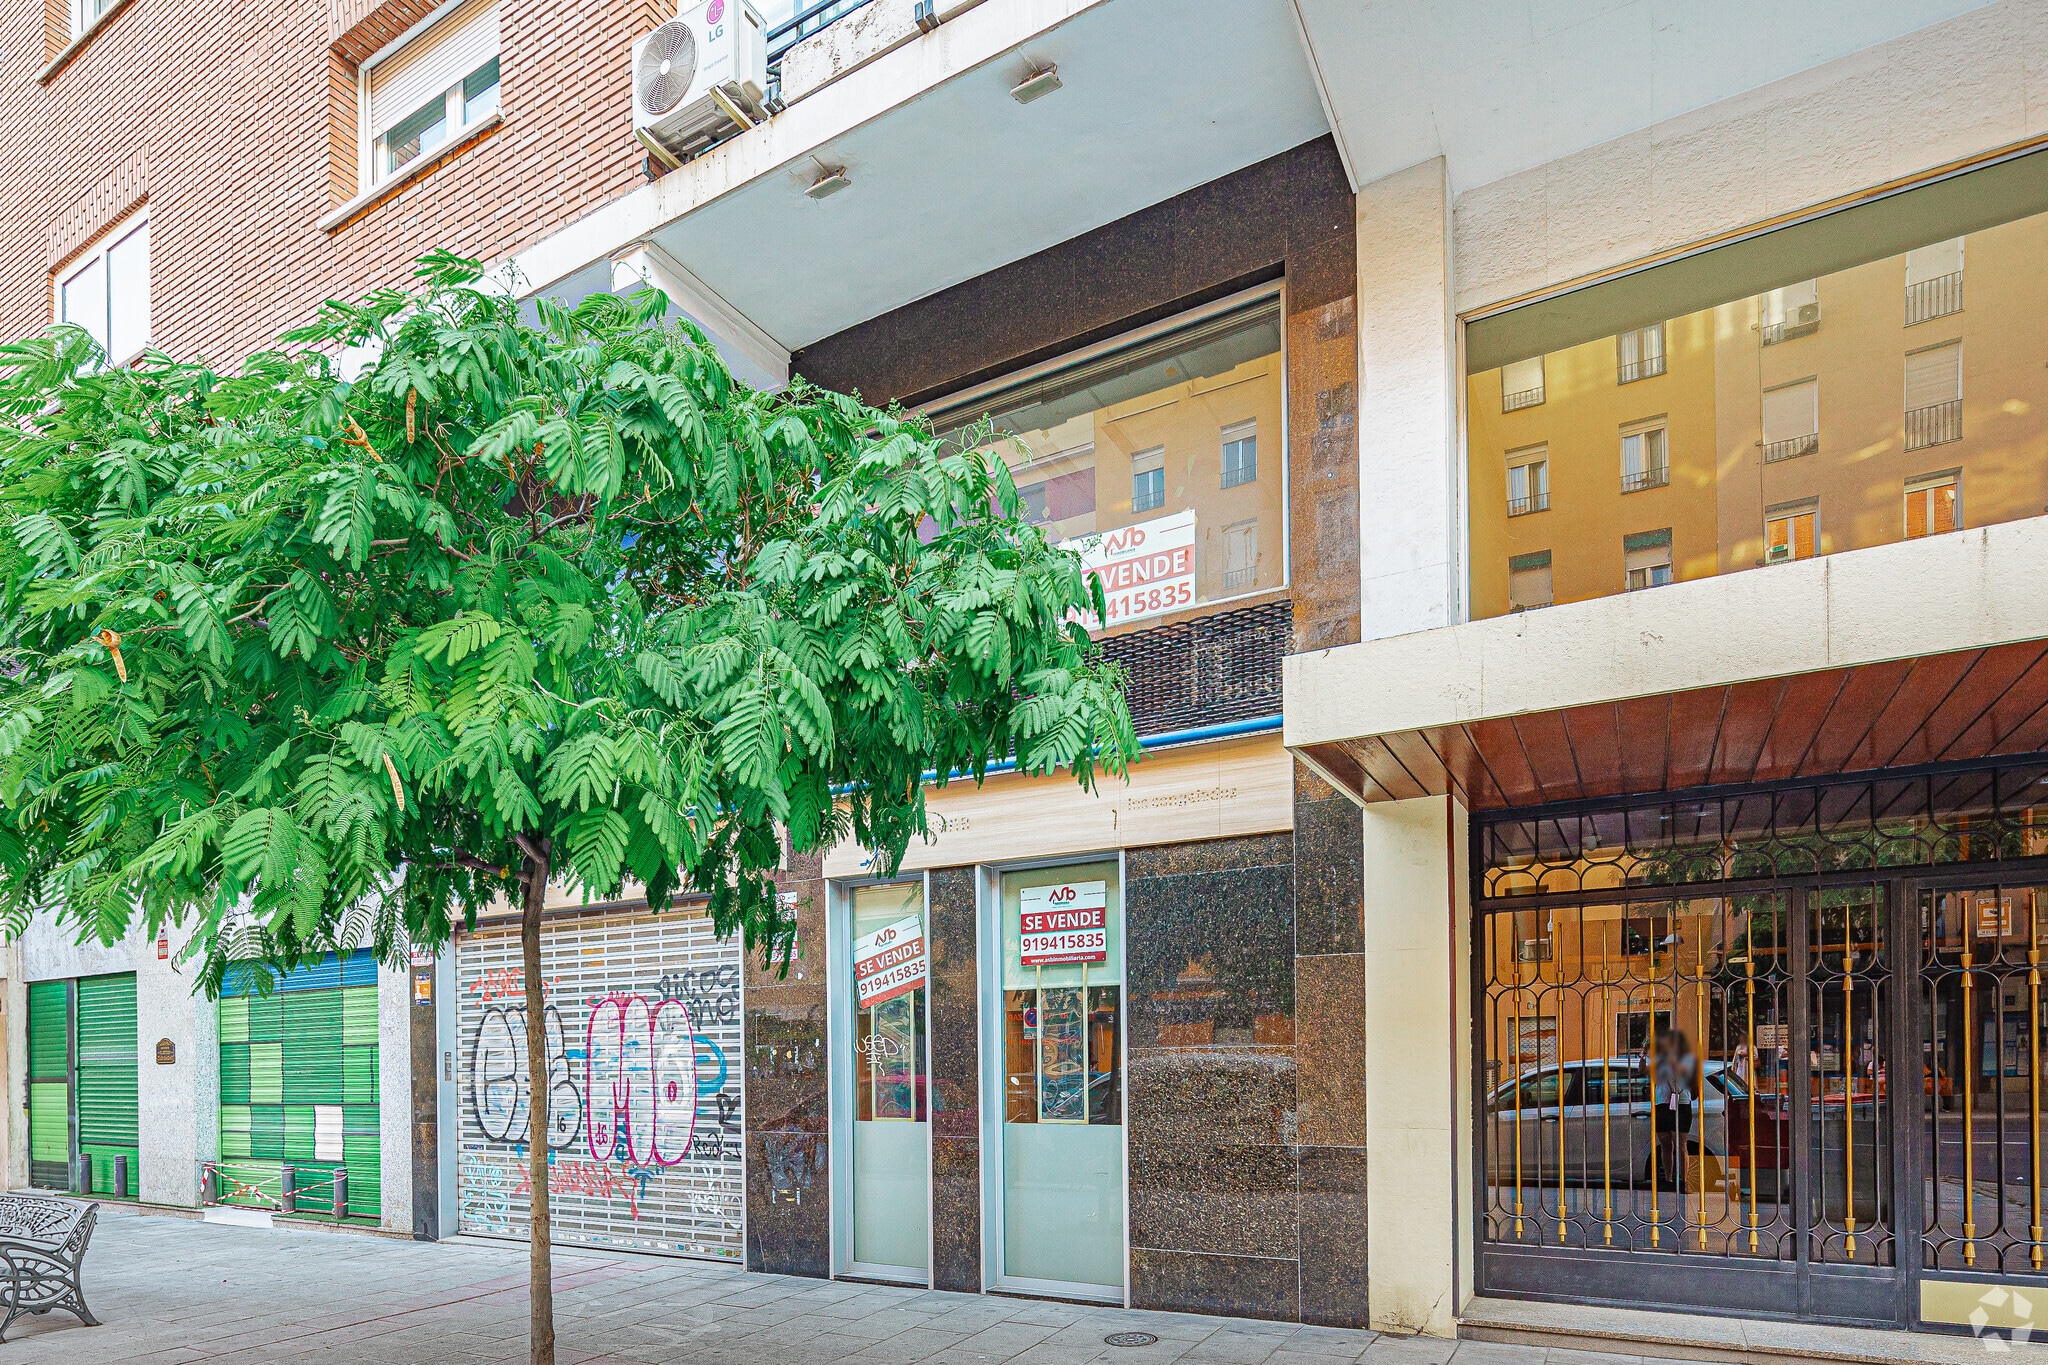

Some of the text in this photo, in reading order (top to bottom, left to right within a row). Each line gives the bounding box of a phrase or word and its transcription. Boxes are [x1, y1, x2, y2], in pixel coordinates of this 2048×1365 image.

[708, 24, 724, 43] LG
[1100, 550, 1186, 590] VENDE
[1025, 910, 1101, 931] SE VENDE
[1022, 933, 1104, 952] 919415835
[859, 960, 875, 977] SE
[876, 941, 921, 970] VENDE
[860, 960, 926, 996] 919415835
